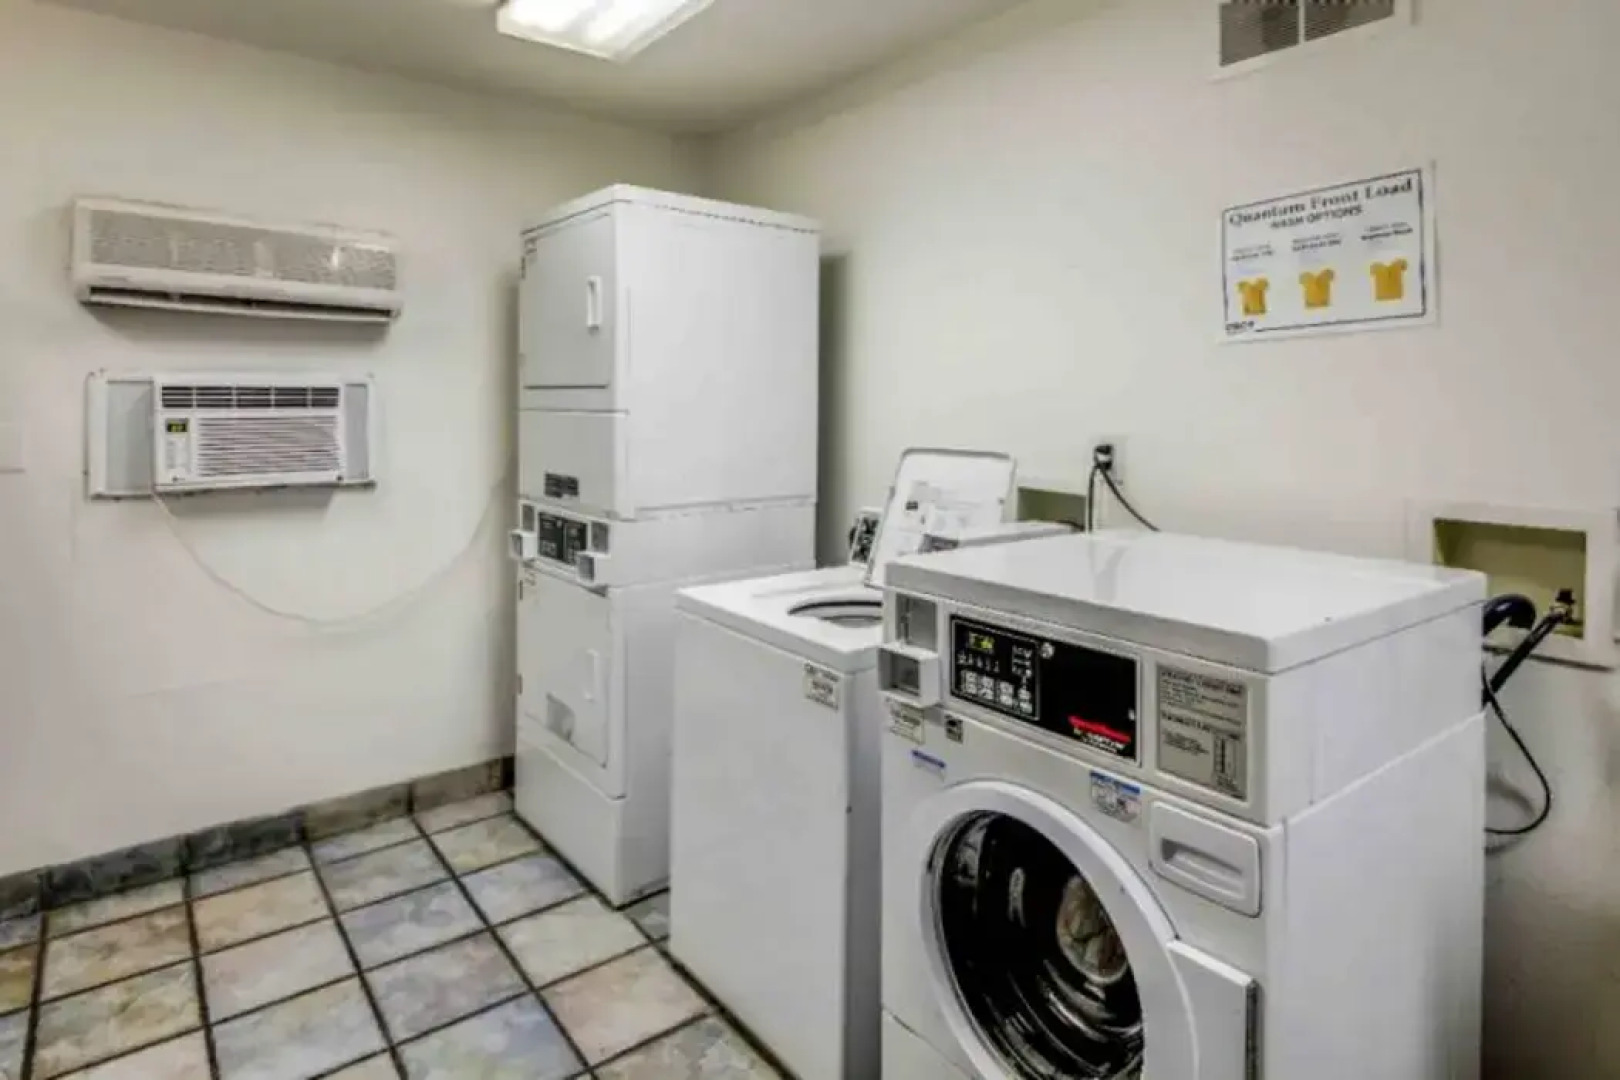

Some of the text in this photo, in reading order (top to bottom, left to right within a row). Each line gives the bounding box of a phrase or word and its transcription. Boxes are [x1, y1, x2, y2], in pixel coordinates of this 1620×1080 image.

[1229, 178, 1412, 225] Quantum Front Load
[1307, 204, 1363, 223] OPTIONS
